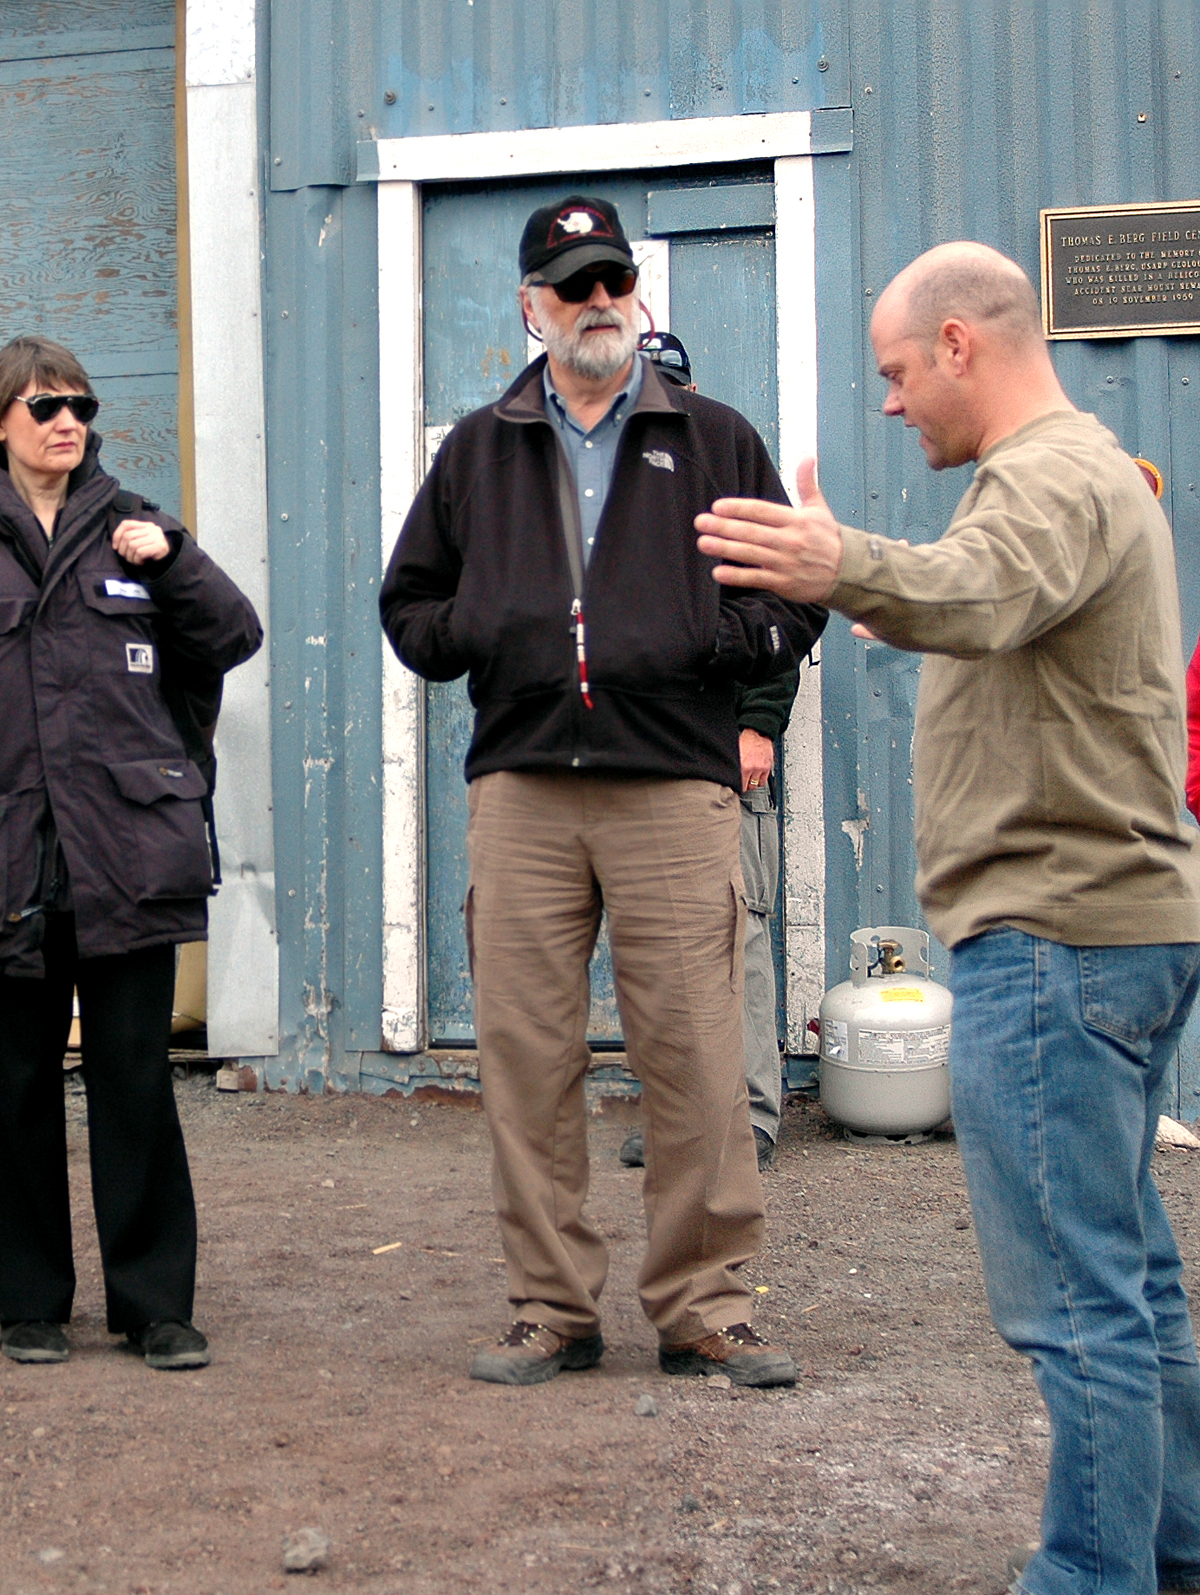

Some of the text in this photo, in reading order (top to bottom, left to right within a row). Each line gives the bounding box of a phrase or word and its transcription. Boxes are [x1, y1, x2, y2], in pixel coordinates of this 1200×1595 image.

[1061, 235, 1102, 247] THOMAS
[1119, 232, 1145, 244] BERG
[1151, 230, 1179, 242] FIELD
[1074, 252, 1122, 263] DEDICATED
[1126, 252, 1136, 260] TO
[1140, 251, 1155, 259] THE
[1160, 249, 1195, 258] MEMORY
[1067, 265, 1102, 274] THOMAS
[1065, 276, 1083, 285] WHO
[1087, 275, 1104, 283] WAS
[1108, 273, 1139, 283] KILLED
[1074, 285, 1116, 296] ACCIDENT
[1120, 284, 1143, 294] NEAR
[1147, 282, 1175, 292] MOUNT
[1122, 294, 1168, 305] NOVEMBER
[1172, 292, 1194, 302] 1969
